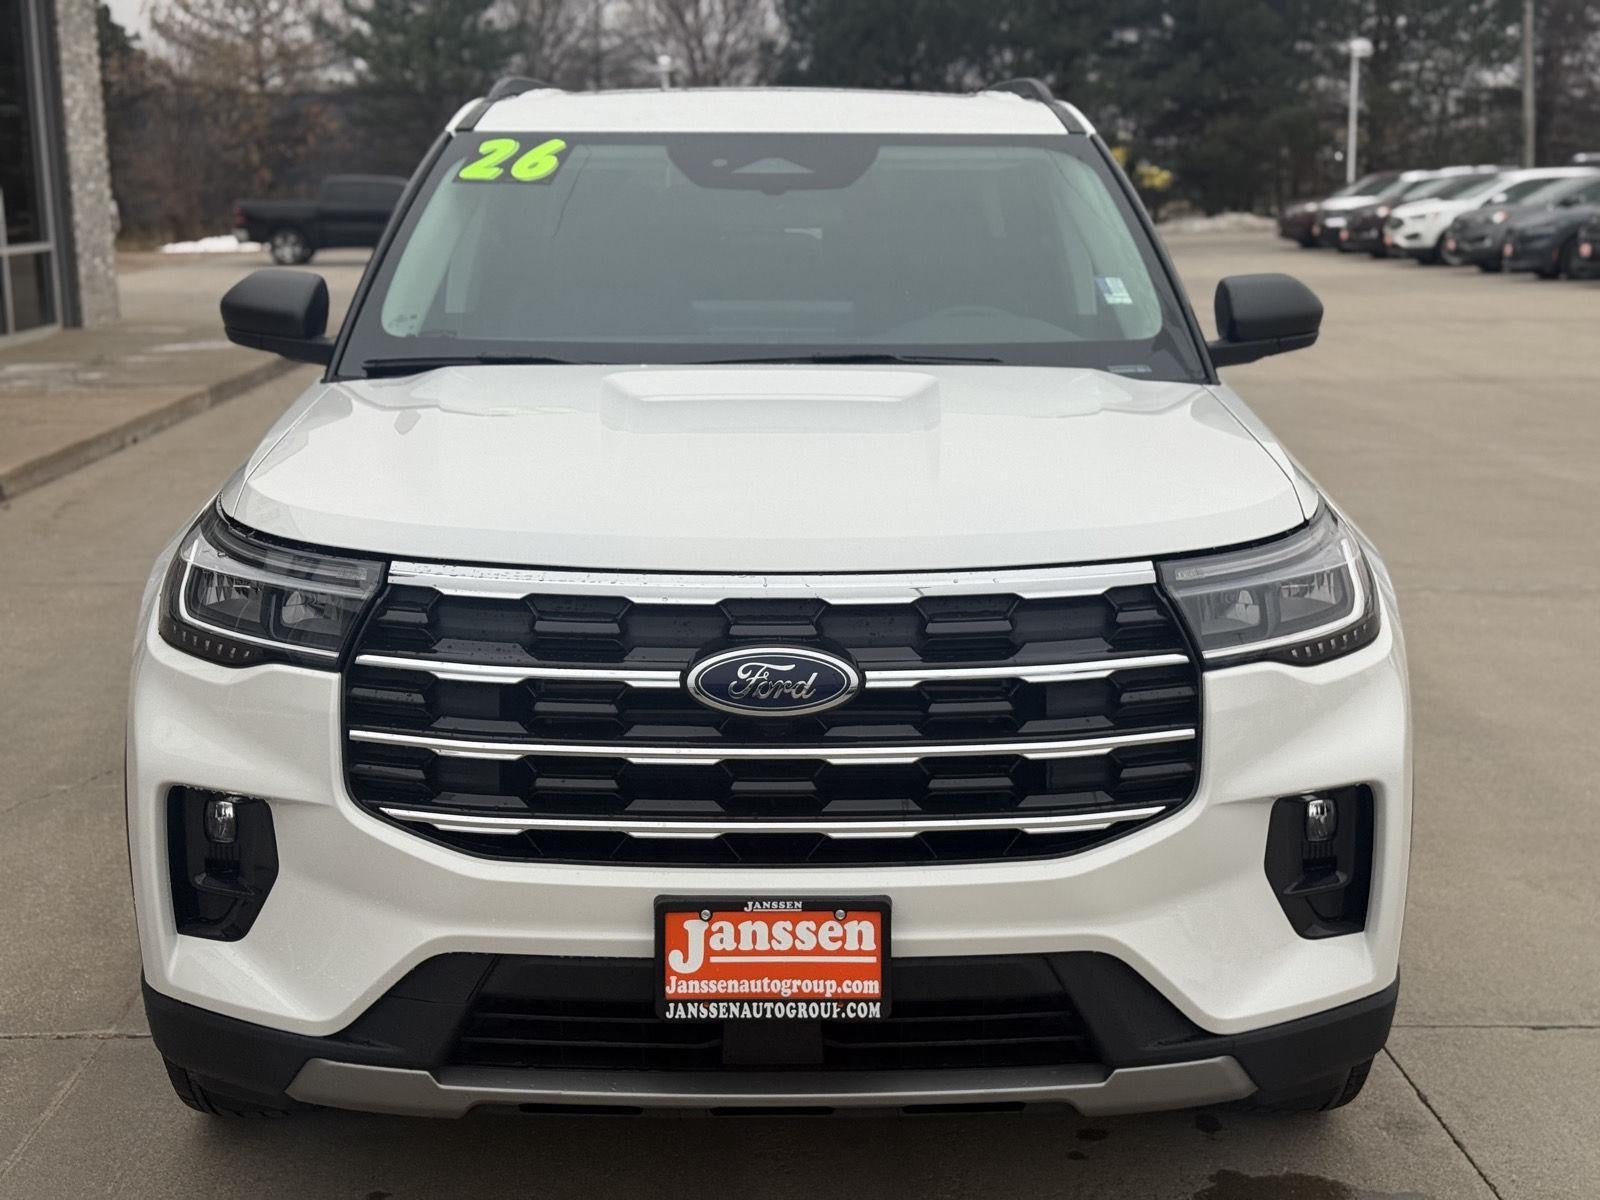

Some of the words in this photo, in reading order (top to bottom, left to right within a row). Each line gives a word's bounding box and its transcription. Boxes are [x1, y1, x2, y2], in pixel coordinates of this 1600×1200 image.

[459, 138, 567, 181] 26
[728, 662, 818, 700] Ford
[744, 901, 803, 912] JANSSEN
[668, 919, 877, 974] Janssen
[665, 975, 880, 997] Janssenautogroup.com
